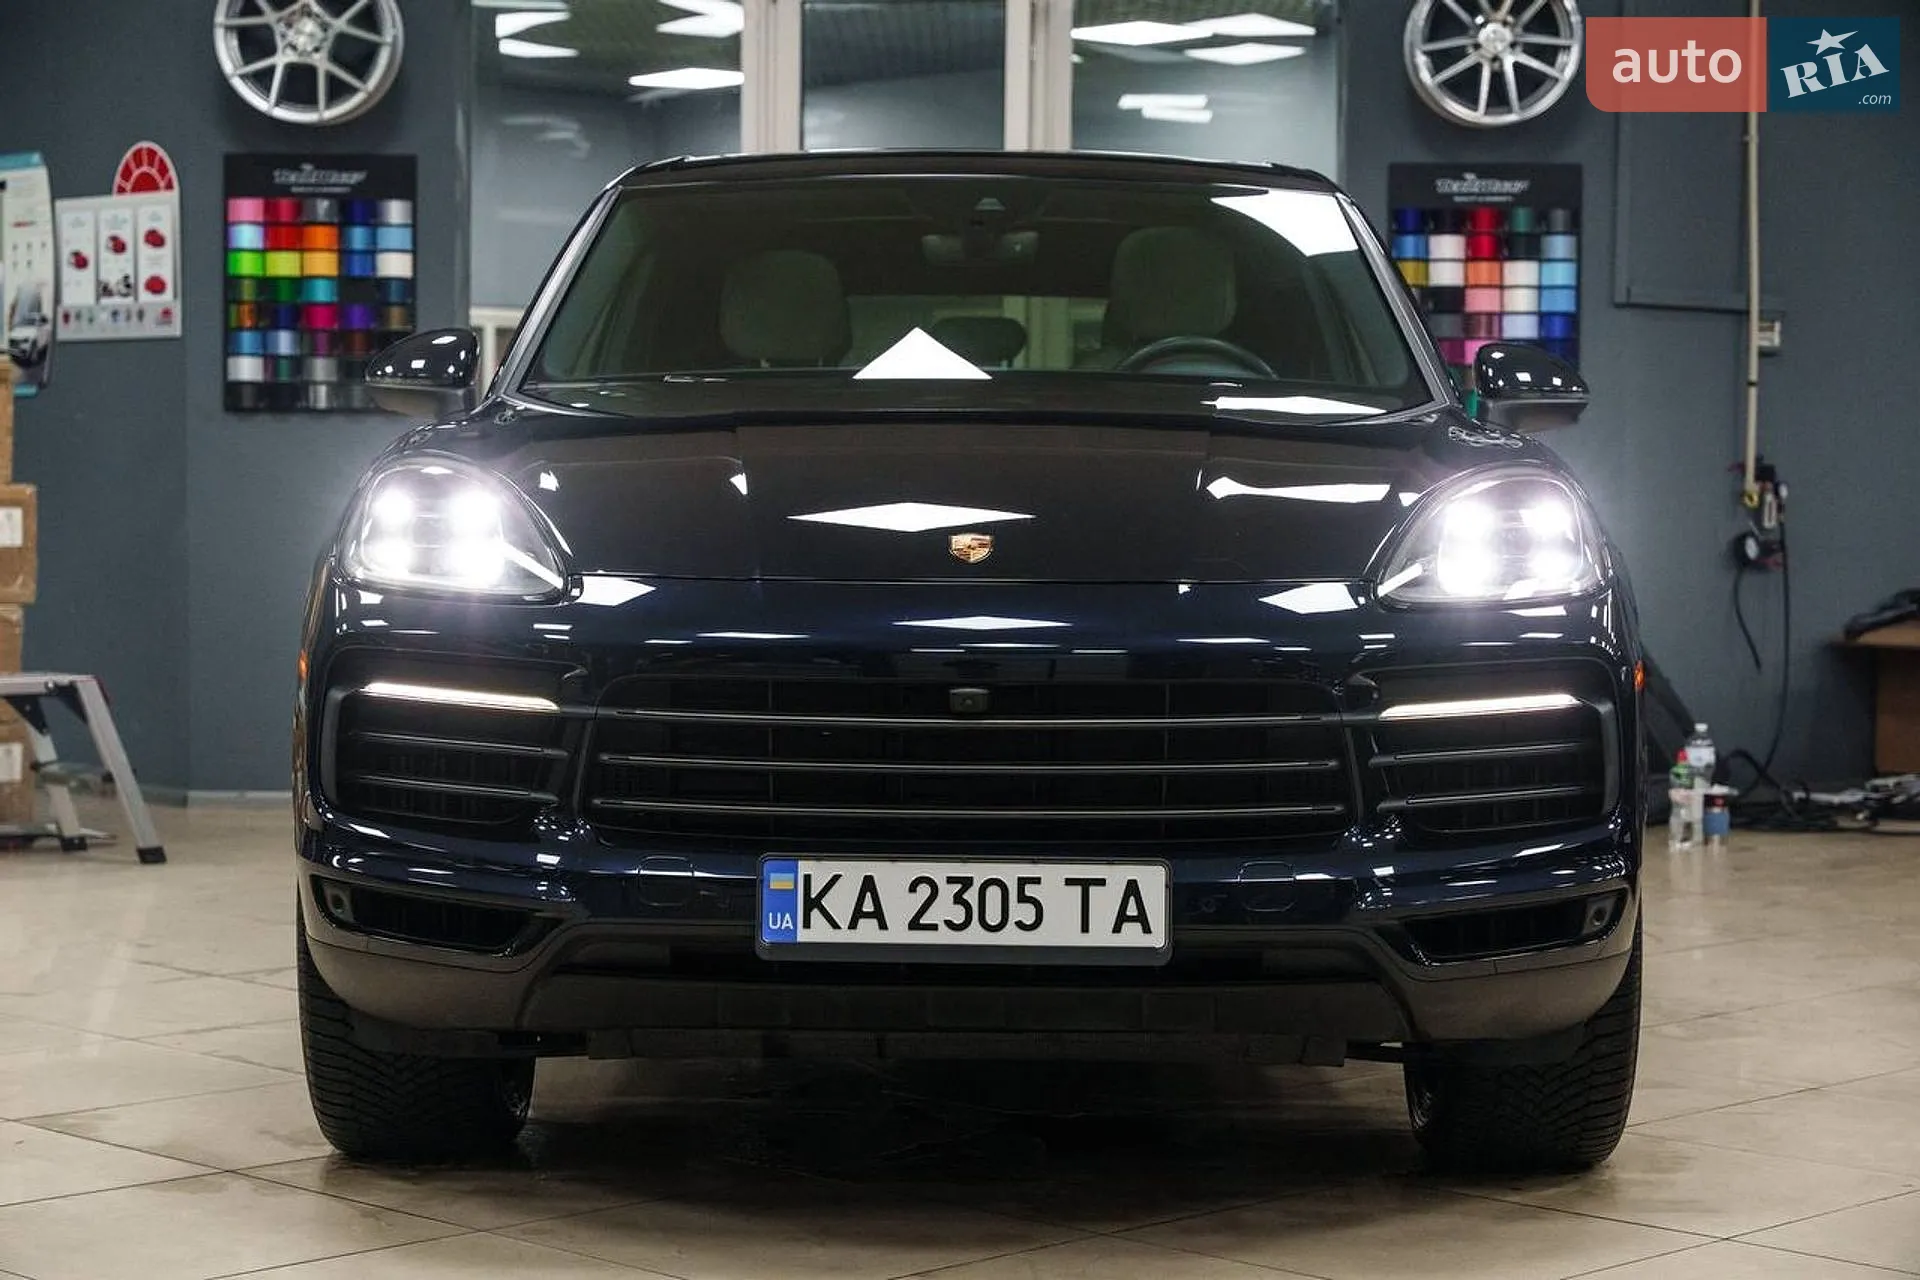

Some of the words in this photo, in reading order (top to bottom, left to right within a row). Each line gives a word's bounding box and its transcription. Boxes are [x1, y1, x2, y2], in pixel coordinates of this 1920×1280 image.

[768, 911, 793, 929] UA
[802, 873, 889, 930] KA
[907, 876, 1044, 932] 2305
[1064, 877, 1152, 934] TA
